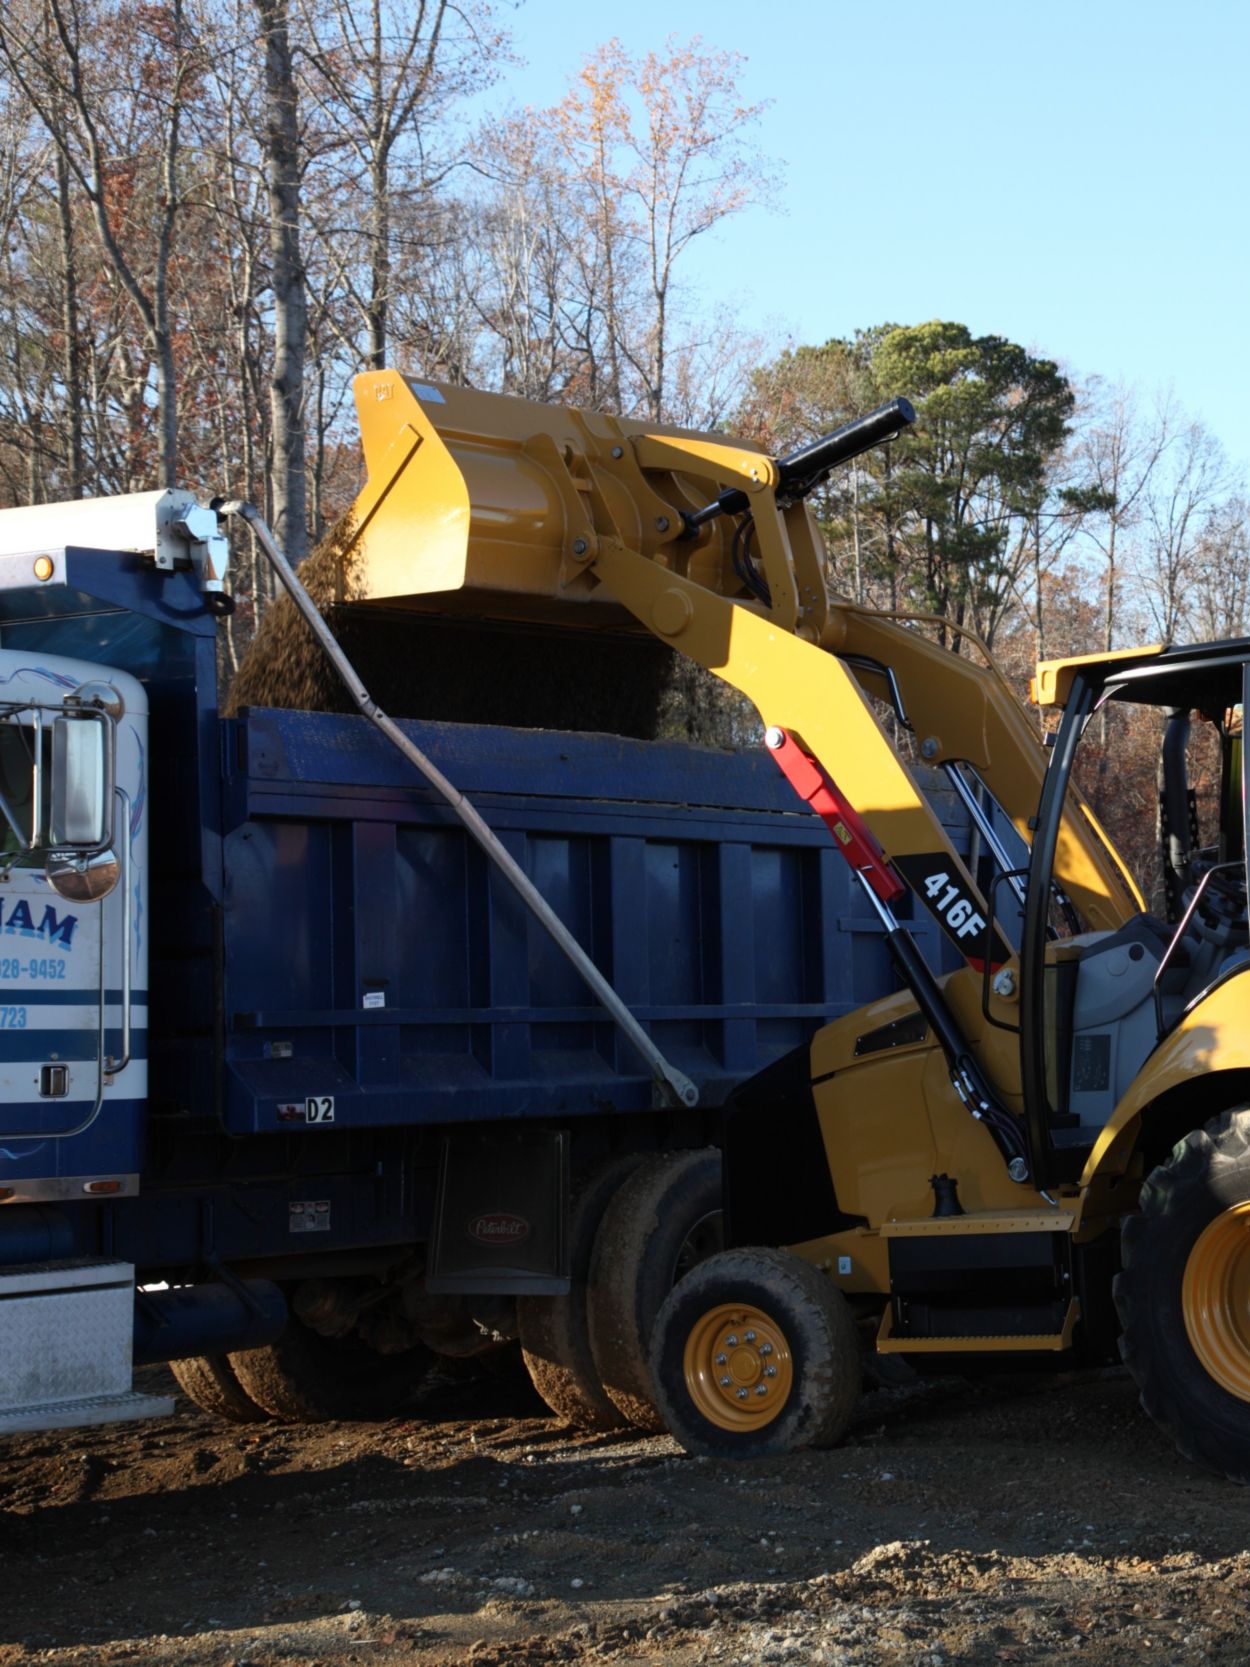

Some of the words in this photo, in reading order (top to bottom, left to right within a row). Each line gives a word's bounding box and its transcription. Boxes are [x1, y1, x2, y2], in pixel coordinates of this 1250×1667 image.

[924, 872, 987, 938] 416F
[0, 959, 66, 979] 28-9452
[0, 1007, 26, 1028] 723
[307, 1098, 333, 1121] D2
